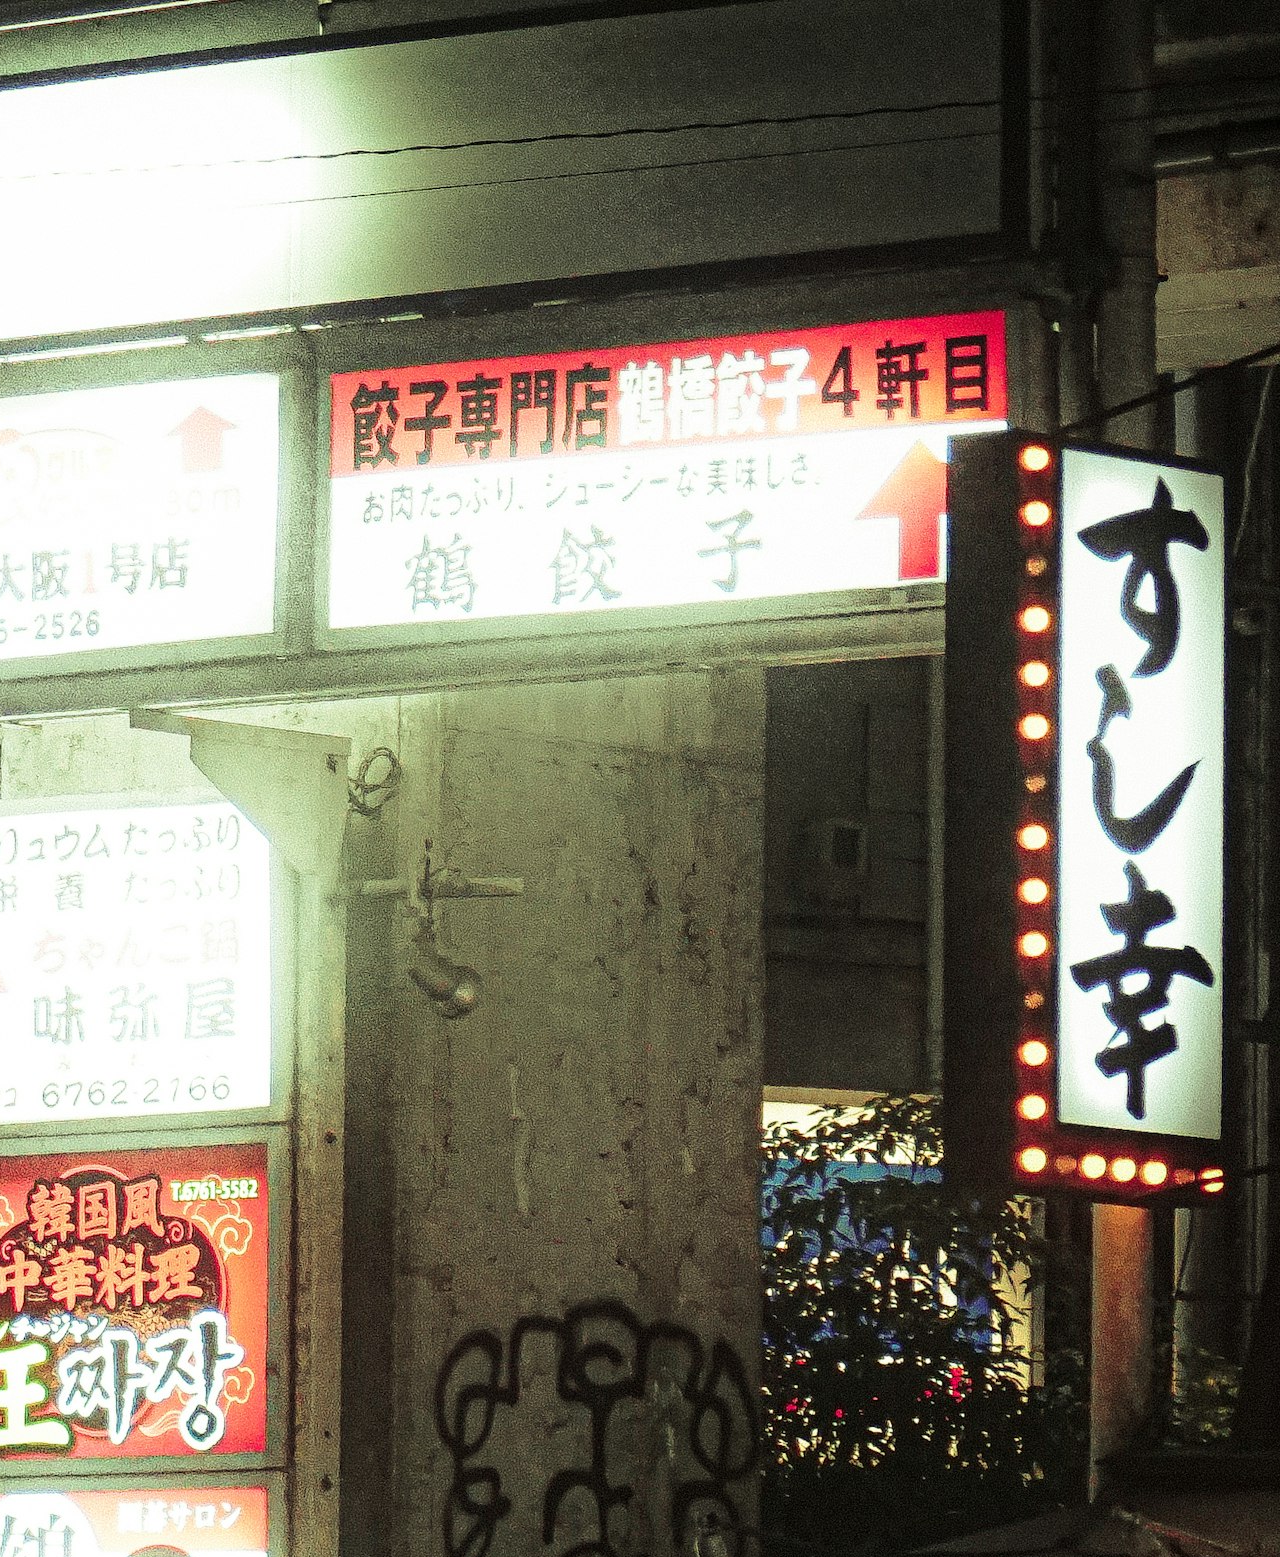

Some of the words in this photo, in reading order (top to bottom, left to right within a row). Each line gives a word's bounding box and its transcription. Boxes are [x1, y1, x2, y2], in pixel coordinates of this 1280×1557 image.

[404, 508, 762, 614] 鶴餃子
[1069, 476, 1215, 1119] すし幸
[29, 1178, 164, 1241] 韓国風
